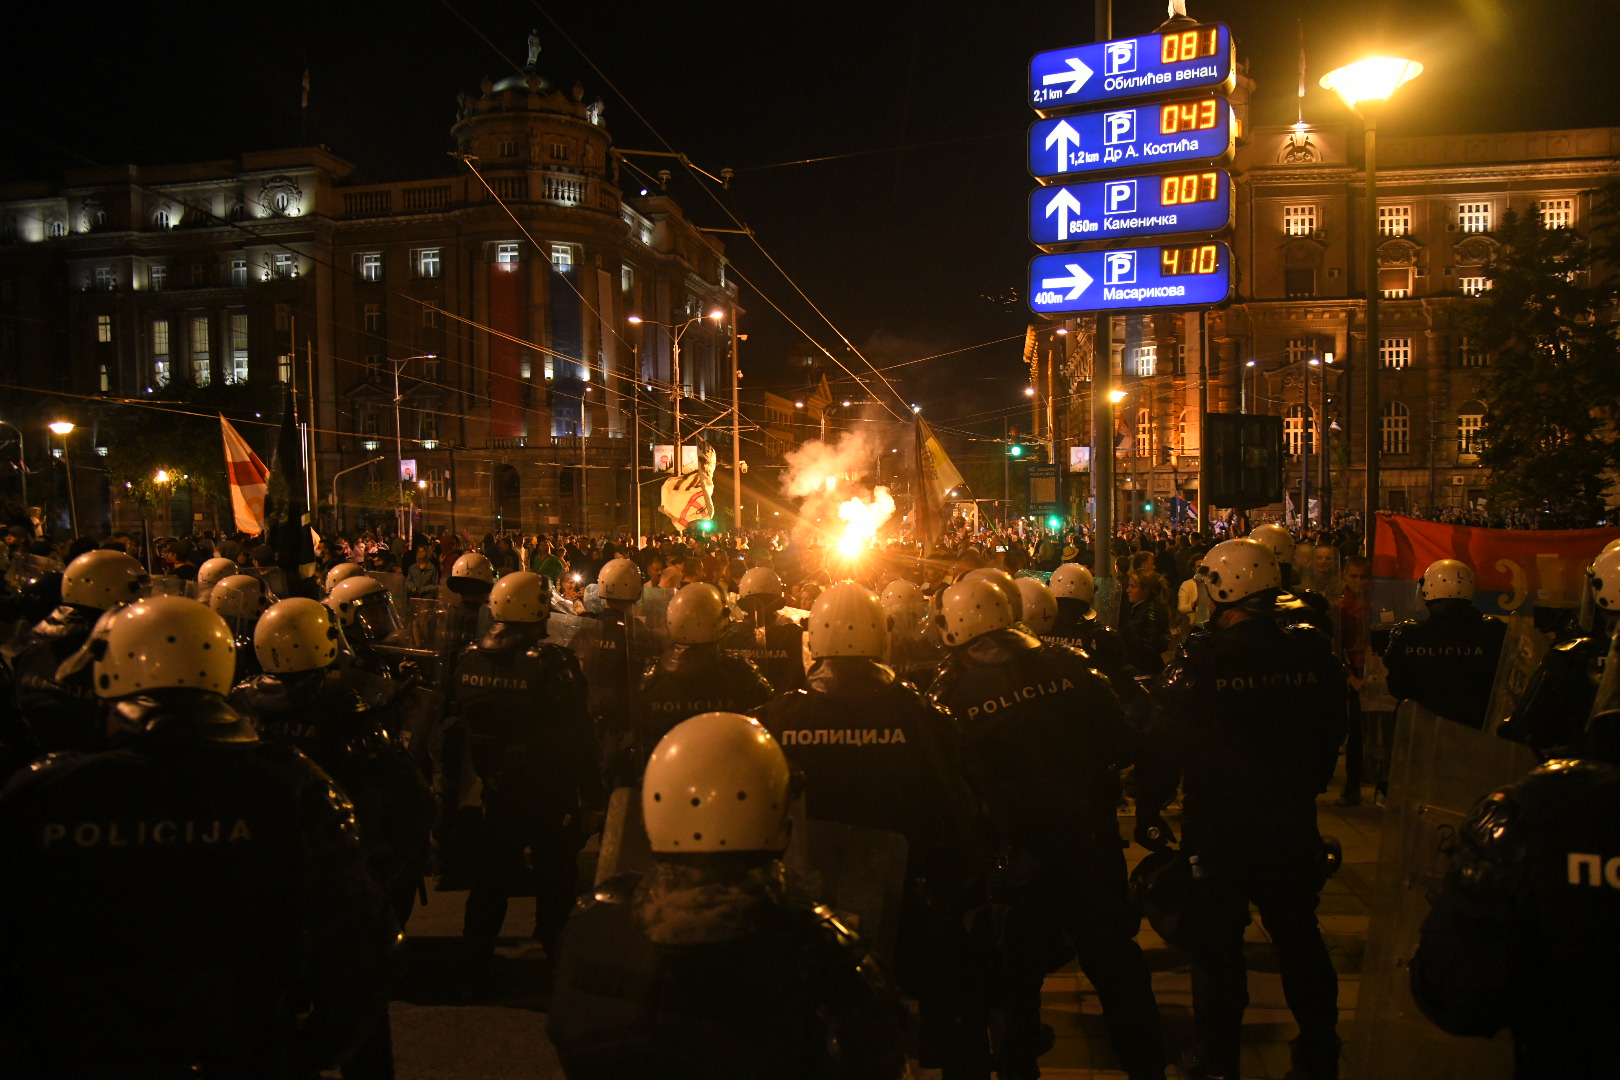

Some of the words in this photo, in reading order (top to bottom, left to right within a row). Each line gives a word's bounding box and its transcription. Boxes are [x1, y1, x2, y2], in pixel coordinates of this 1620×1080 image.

[1163, 29, 1217, 63] 081
[1104, 71, 1172, 91] Обилићев
[1176, 64, 1218, 80] венац
[1163, 101, 1216, 134] 043
[1104, 147, 1122, 163] Др
[1125, 146, 1139, 158] А.
[1143, 139, 1199, 156] Костића
[1163, 174, 1216, 205] 007
[1070, 220, 1098, 233] 850m
[1104, 214, 1177, 230] Каменичка
[1163, 246, 1216, 274] 410
[1035, 292, 1063, 305] 400m
[1104, 285, 1185, 301] Масарикова
[1405, 646, 1484, 657] POLICIJA
[461, 673, 528, 690] POLICIJA
[1215, 671, 1319, 693] POLICIJA
[651, 699, 735, 713] POLICIJA
[967, 677, 1075, 721] POLICIJA
[781, 728, 907, 747] ПОЛИЦИЈА
[42, 818, 253, 849] POLICIJA
